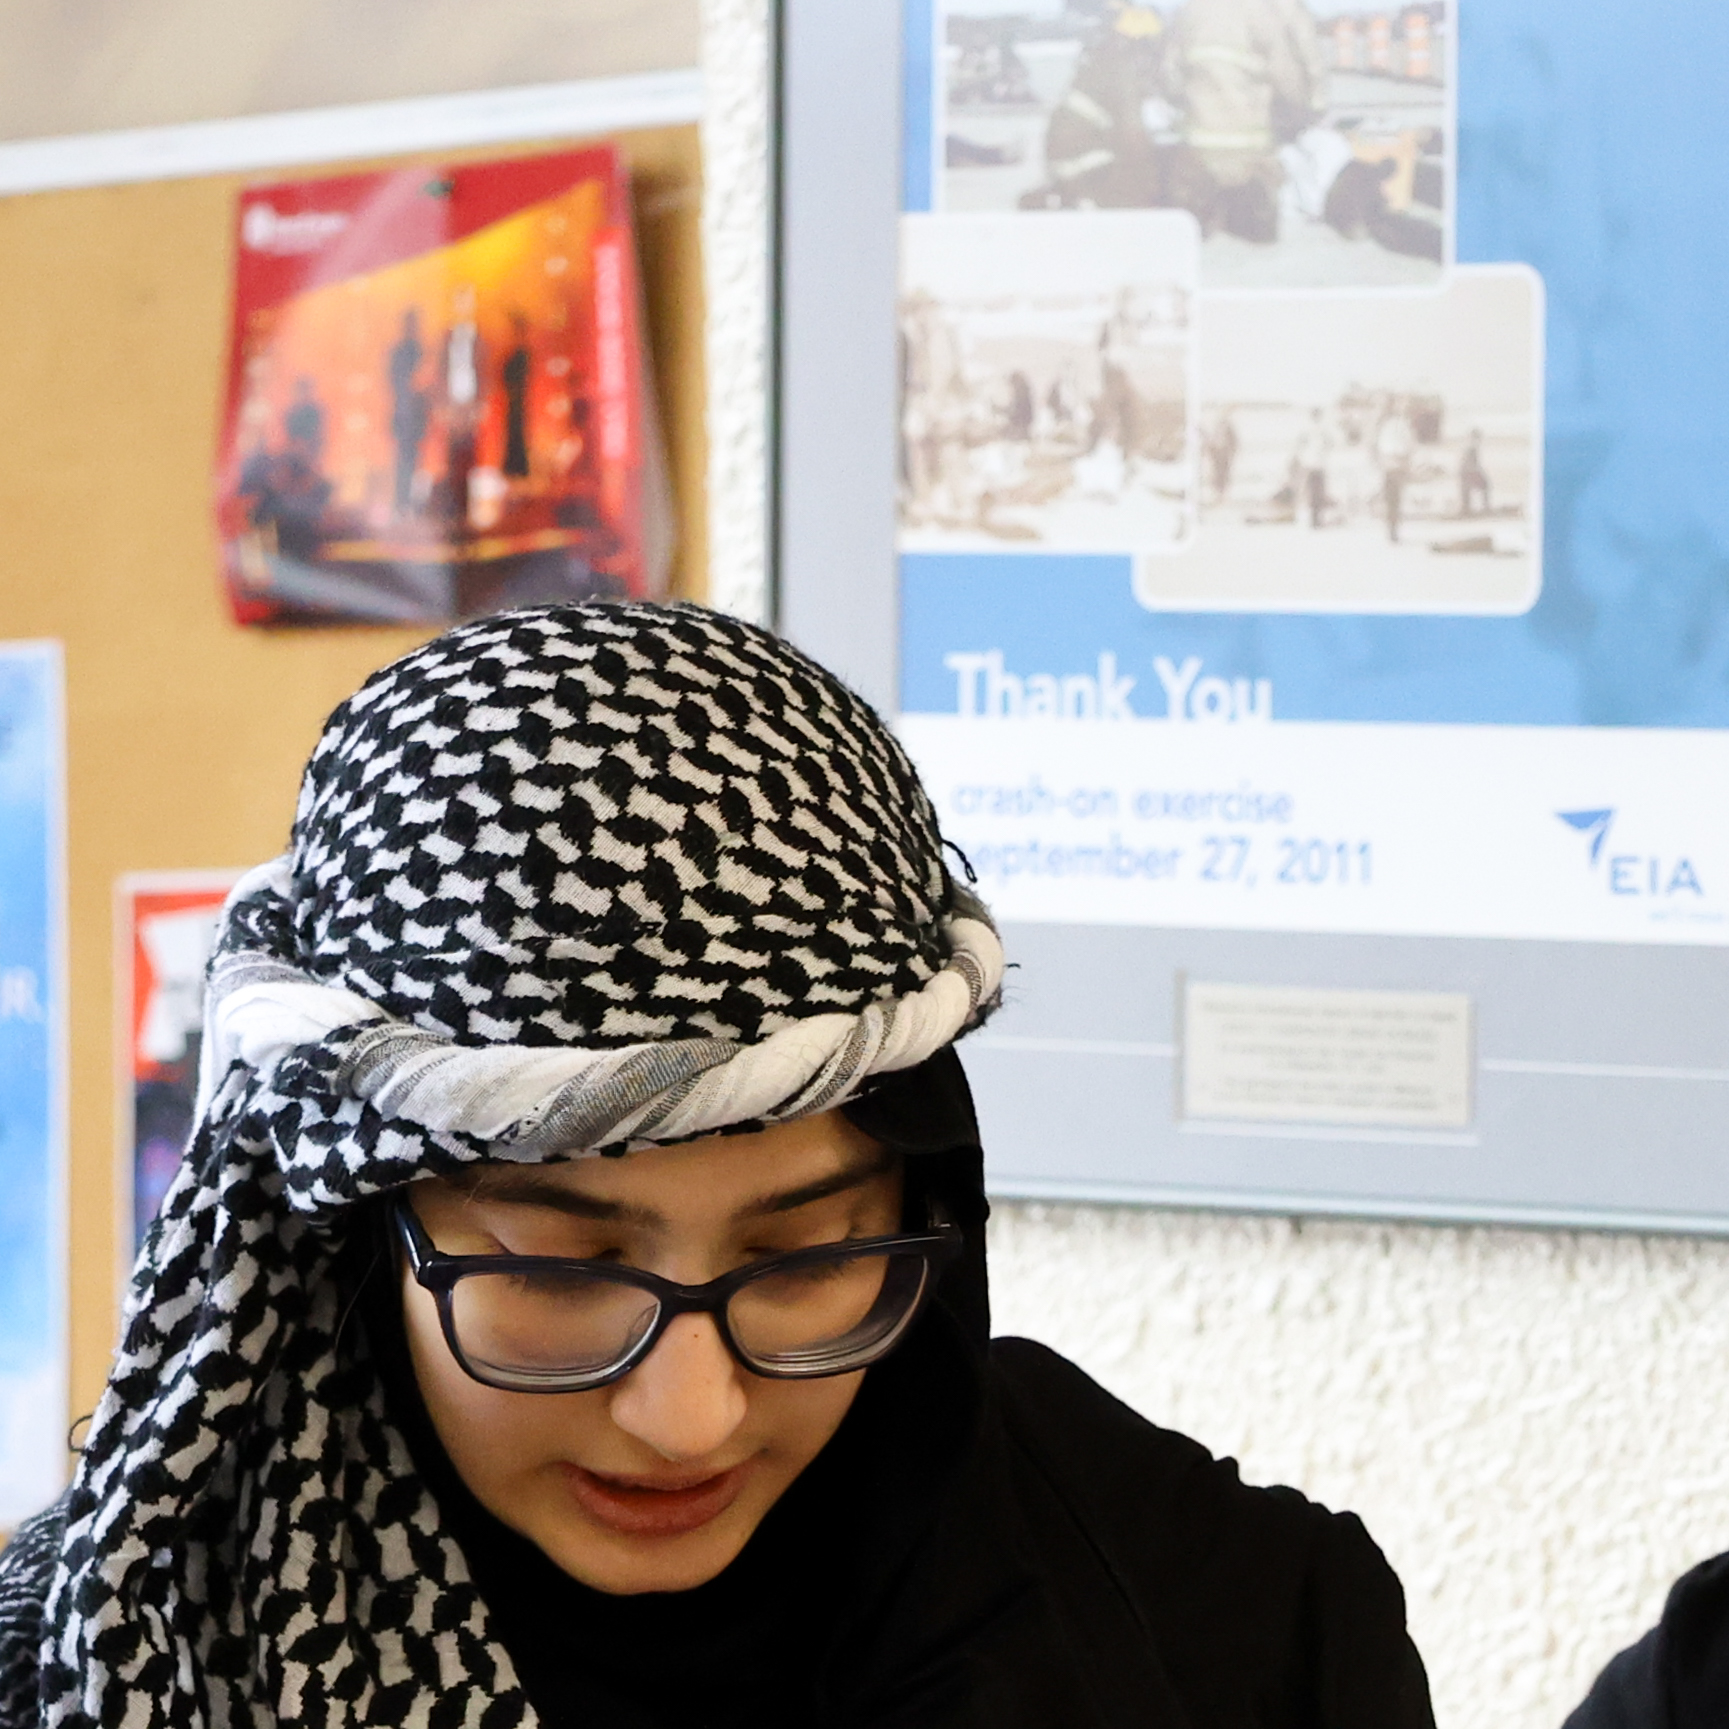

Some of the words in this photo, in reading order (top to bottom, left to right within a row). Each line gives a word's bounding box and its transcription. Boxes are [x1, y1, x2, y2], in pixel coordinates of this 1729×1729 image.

[944, 650, 1136, 718] Thank
[1152, 655, 1273, 722] You
[1130, 779, 1296, 823] exercise
[1200, 834, 1256, 888] 27,
[1275, 838, 1372, 886] 2011
[1609, 855, 1704, 896] EIA
